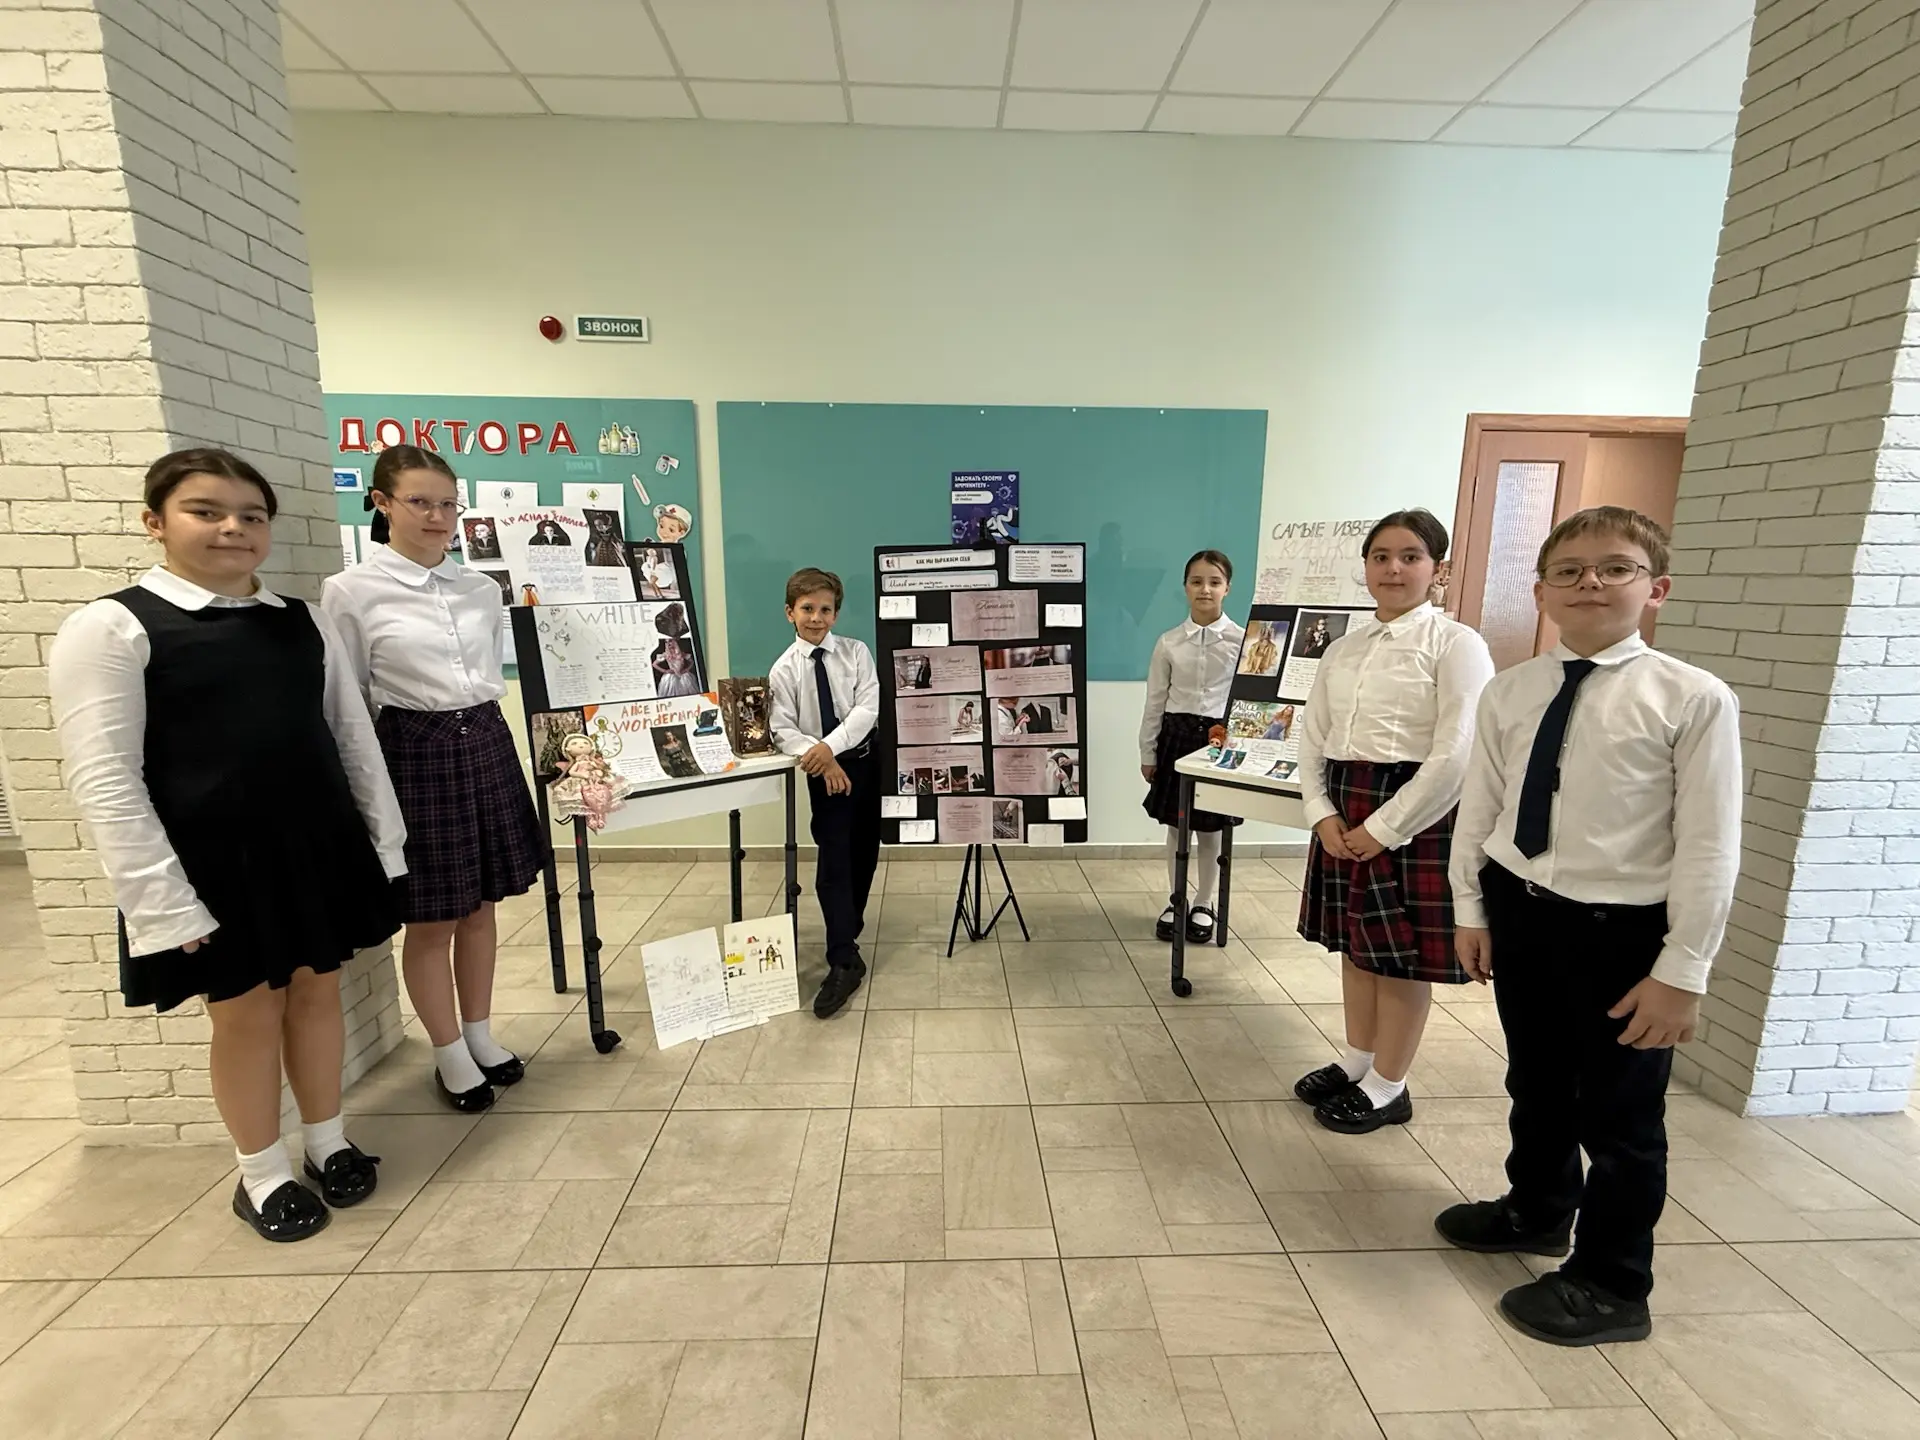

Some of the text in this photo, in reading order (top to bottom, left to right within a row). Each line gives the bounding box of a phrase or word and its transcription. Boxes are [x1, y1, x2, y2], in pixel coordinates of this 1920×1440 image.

[584, 321, 640, 334] ЗВОНОК
[339, 417, 579, 455] ДОКТОРА
[500, 513, 549, 527] КРАСНАЯ
[1272, 520, 1380, 540] САМЫЕ ИЗВЕС
[1305, 559, 1336, 575] МЫ
[576, 604, 654, 625] WHITE
